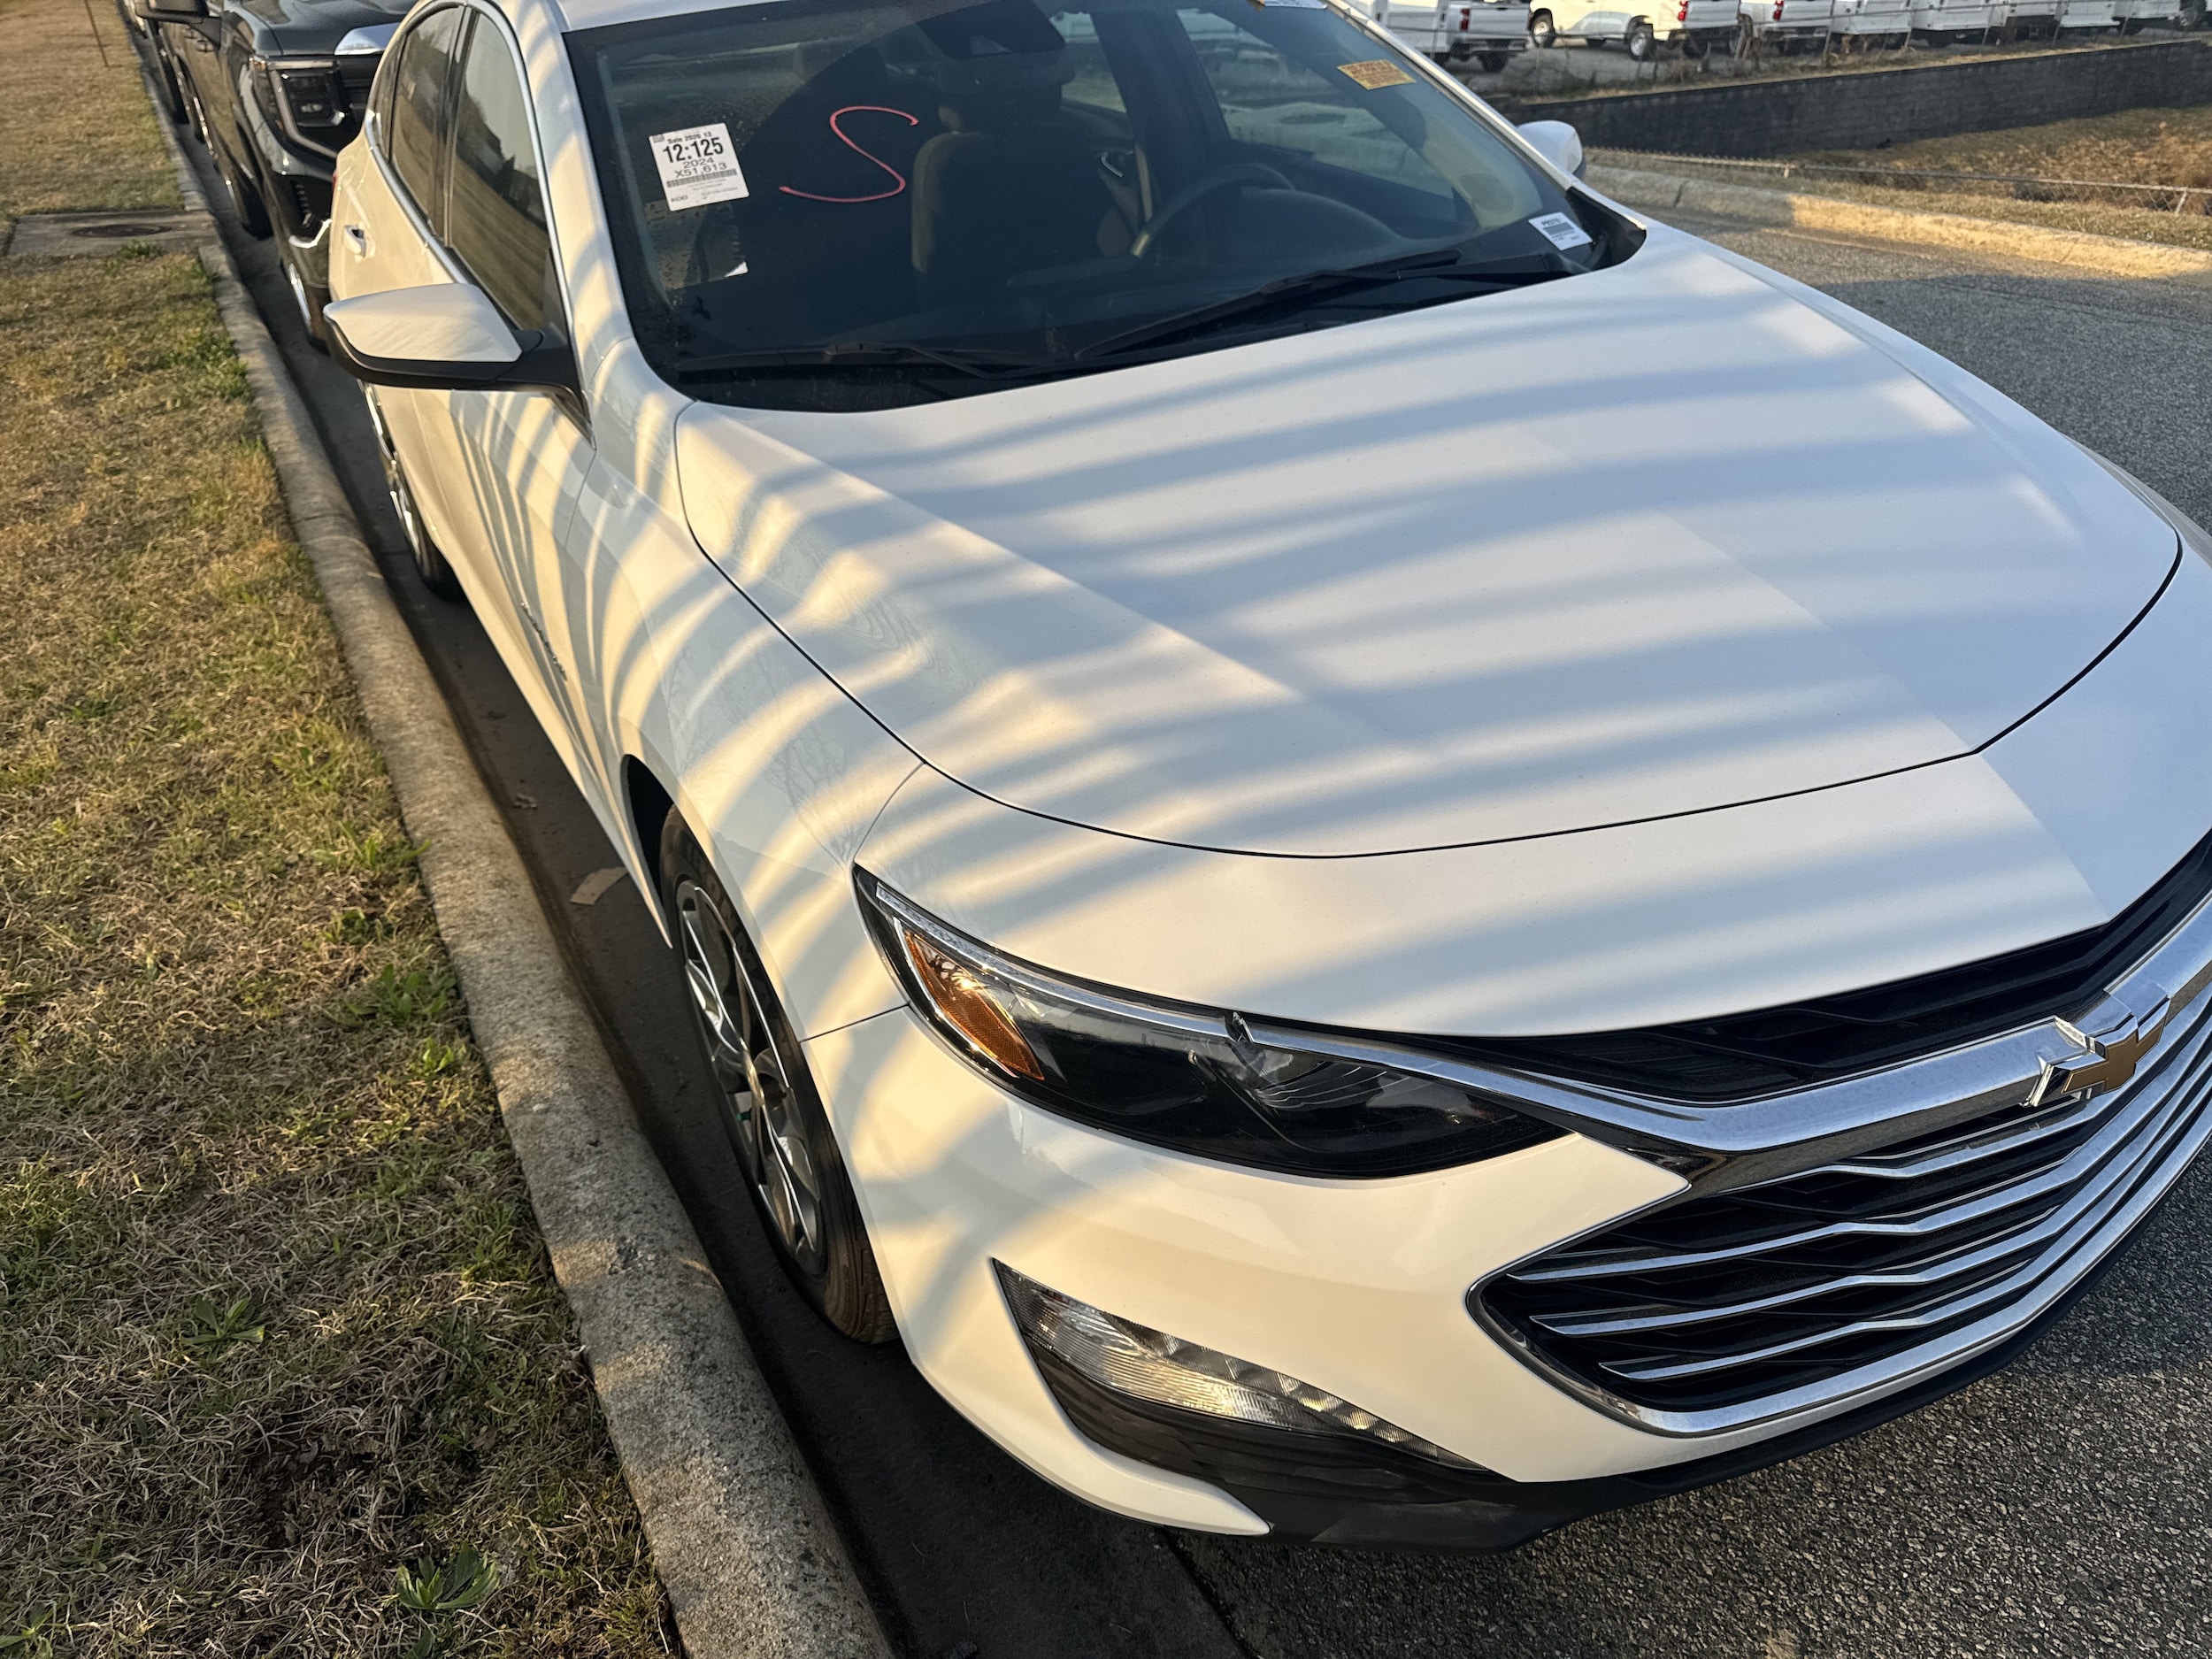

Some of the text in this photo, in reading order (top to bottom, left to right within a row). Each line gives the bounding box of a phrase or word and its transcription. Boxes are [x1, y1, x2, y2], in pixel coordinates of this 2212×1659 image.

[667, 136, 683, 145] Sale
[663, 137, 724, 164] 12:125
[780, 106, 918, 203] S
[682, 157, 714, 169] 2024
